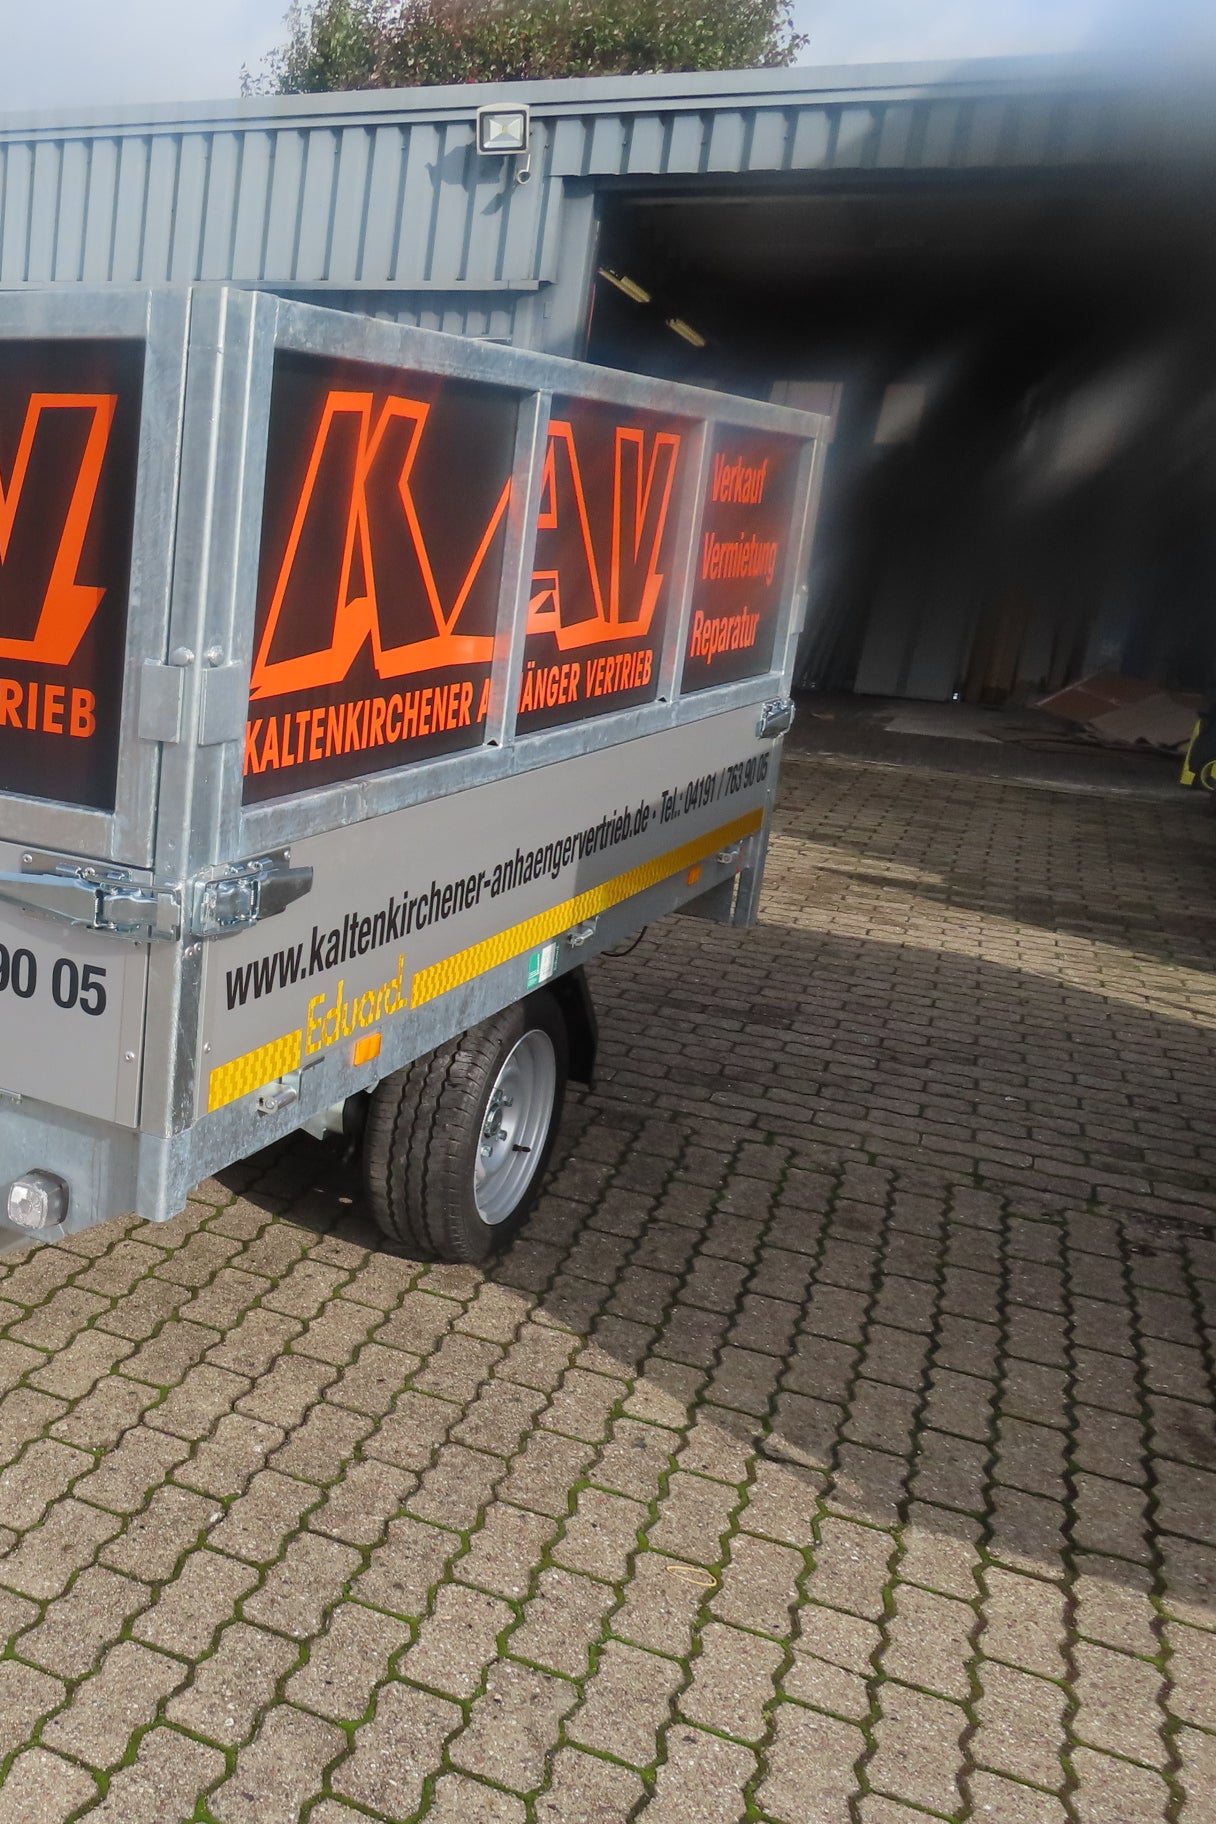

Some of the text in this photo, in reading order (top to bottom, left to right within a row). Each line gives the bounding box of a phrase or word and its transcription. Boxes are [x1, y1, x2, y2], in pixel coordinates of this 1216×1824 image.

[712, 453, 768, 504] Verkauf
[249, 390, 681, 700] KAV
[702, 532, 778, 587] Vermietung
[690, 606, 760, 665] Reparatur
[243, 680, 472, 776] KALTENKIRCHENER
[584, 650, 654, 699] VERTRIEB
[226, 799, 650, 1010] www.kaltenkirchener-anhaengervertrieb.de
[684, 771, 717, 814] 04191
[725, 761, 744, 797] 763
[744, 756, 757, 789] 90
[756, 751, 770, 783] 05
[51, 958, 107, 1016] 05
[305, 952, 408, 1057] Eduard
